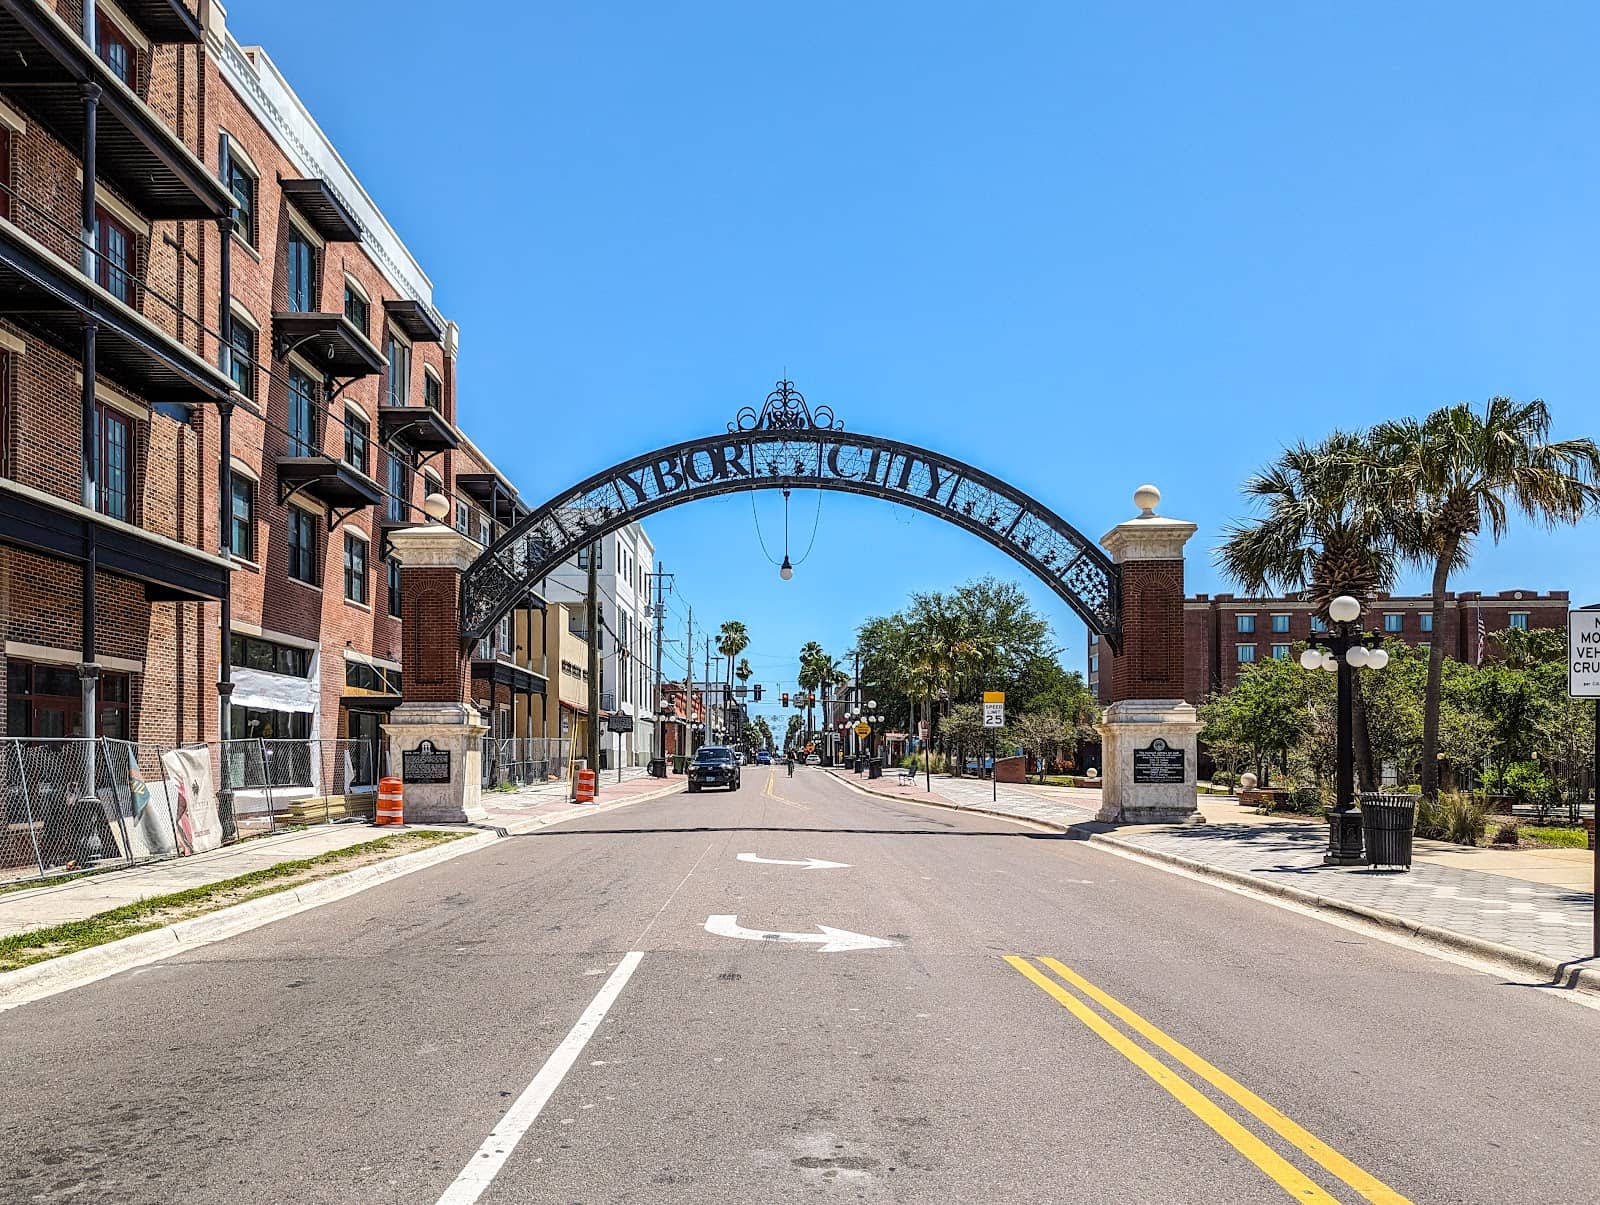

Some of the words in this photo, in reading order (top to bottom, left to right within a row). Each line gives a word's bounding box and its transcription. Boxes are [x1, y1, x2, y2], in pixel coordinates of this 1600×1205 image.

[620, 442, 751, 501] YBOR
[827, 443, 955, 498] CITY
[1573, 661, 1600, 673] CRU
[986, 715, 1002, 724] 25
